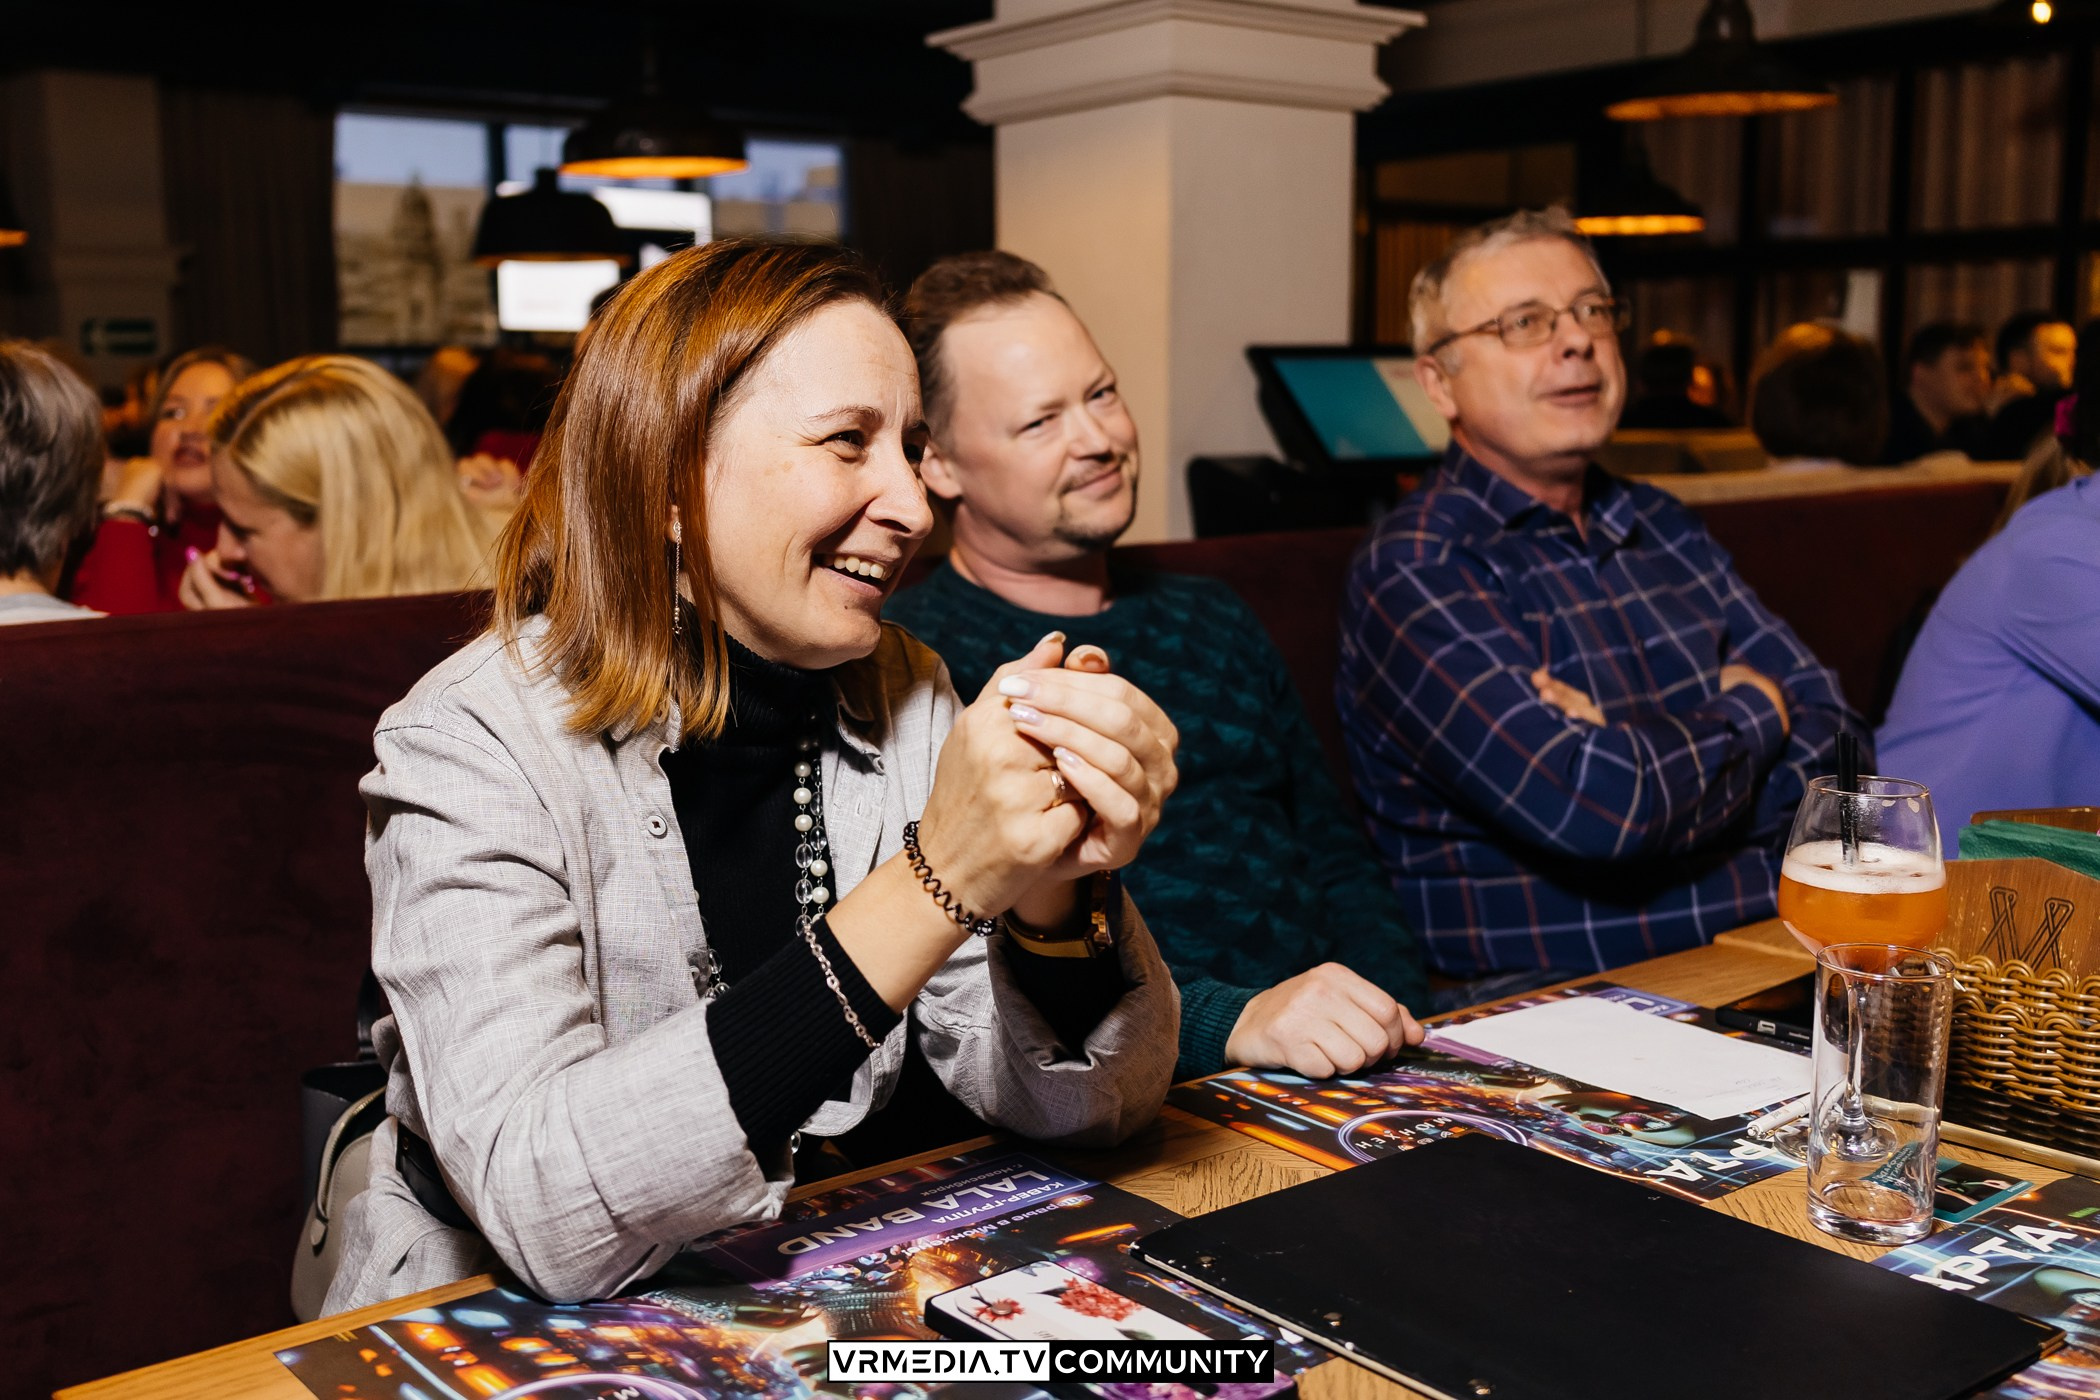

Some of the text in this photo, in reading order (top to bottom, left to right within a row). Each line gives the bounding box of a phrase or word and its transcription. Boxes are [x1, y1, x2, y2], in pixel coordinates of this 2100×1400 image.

[777, 1170, 1051, 1256] LALA BAND
[931, 1181, 1065, 1225] КАВЕР-ГРУППА
